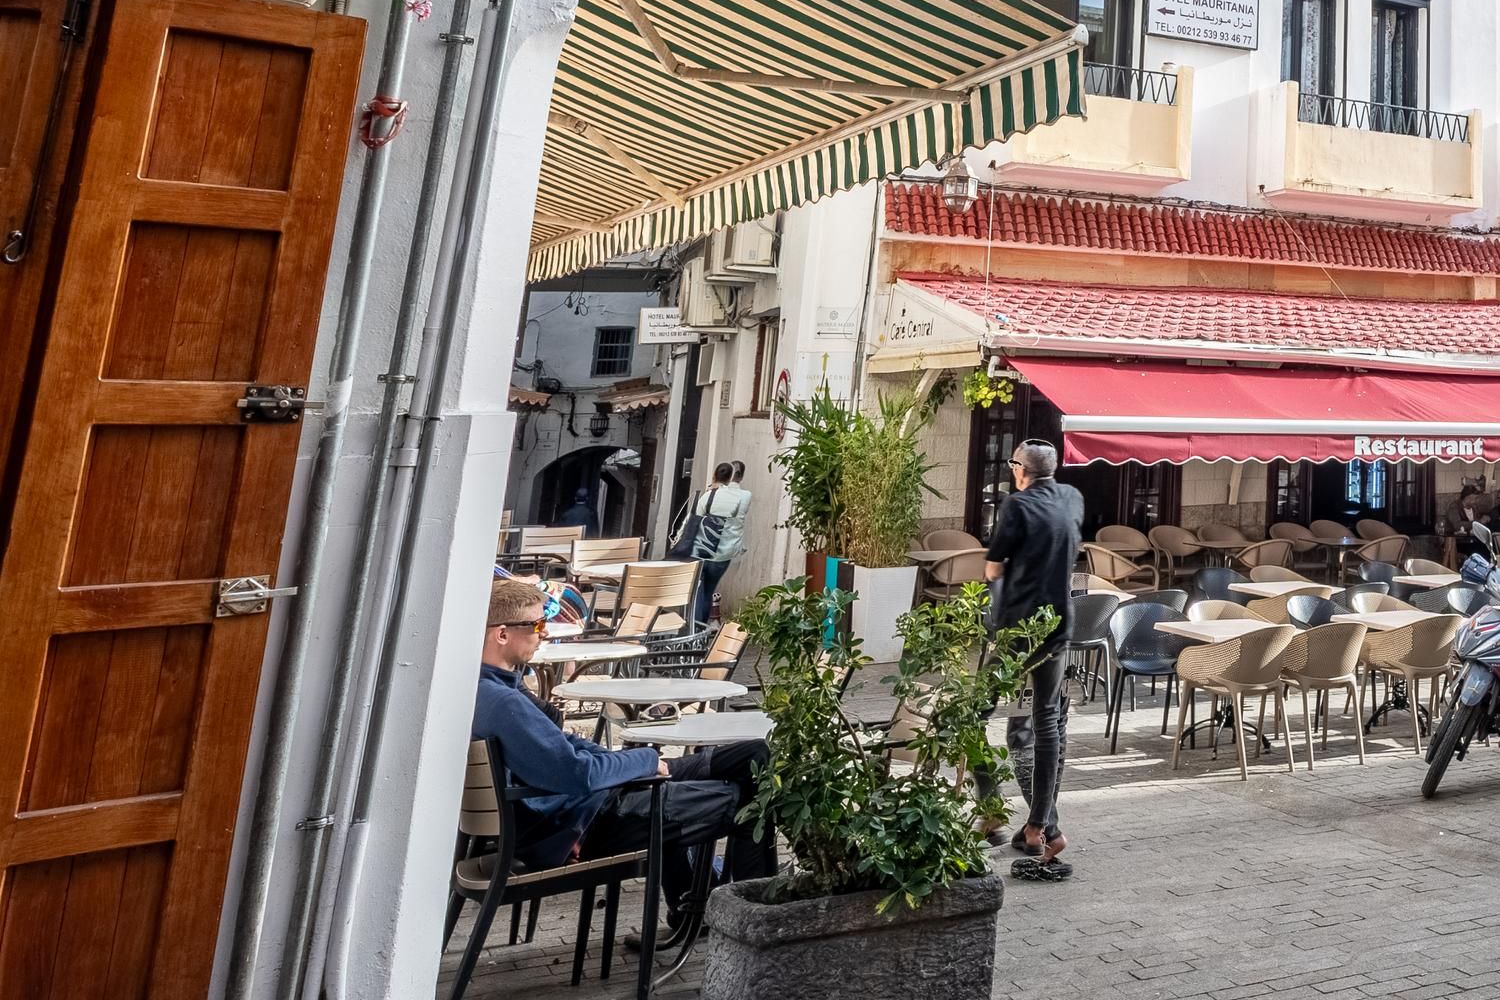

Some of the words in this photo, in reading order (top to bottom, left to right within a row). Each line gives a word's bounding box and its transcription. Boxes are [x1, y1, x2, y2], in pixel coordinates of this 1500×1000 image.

[1155, 21, 1175, 33] TEL:
[1176, 25, 1202, 37] 00212
[1203, 29, 1218, 40] 539
[1219, 31, 1230, 42] 93
[1231, 34, 1241, 43] 46
[1243, 35, 1253, 45] 77
[1354, 435, 1484, 456] Restaurant
